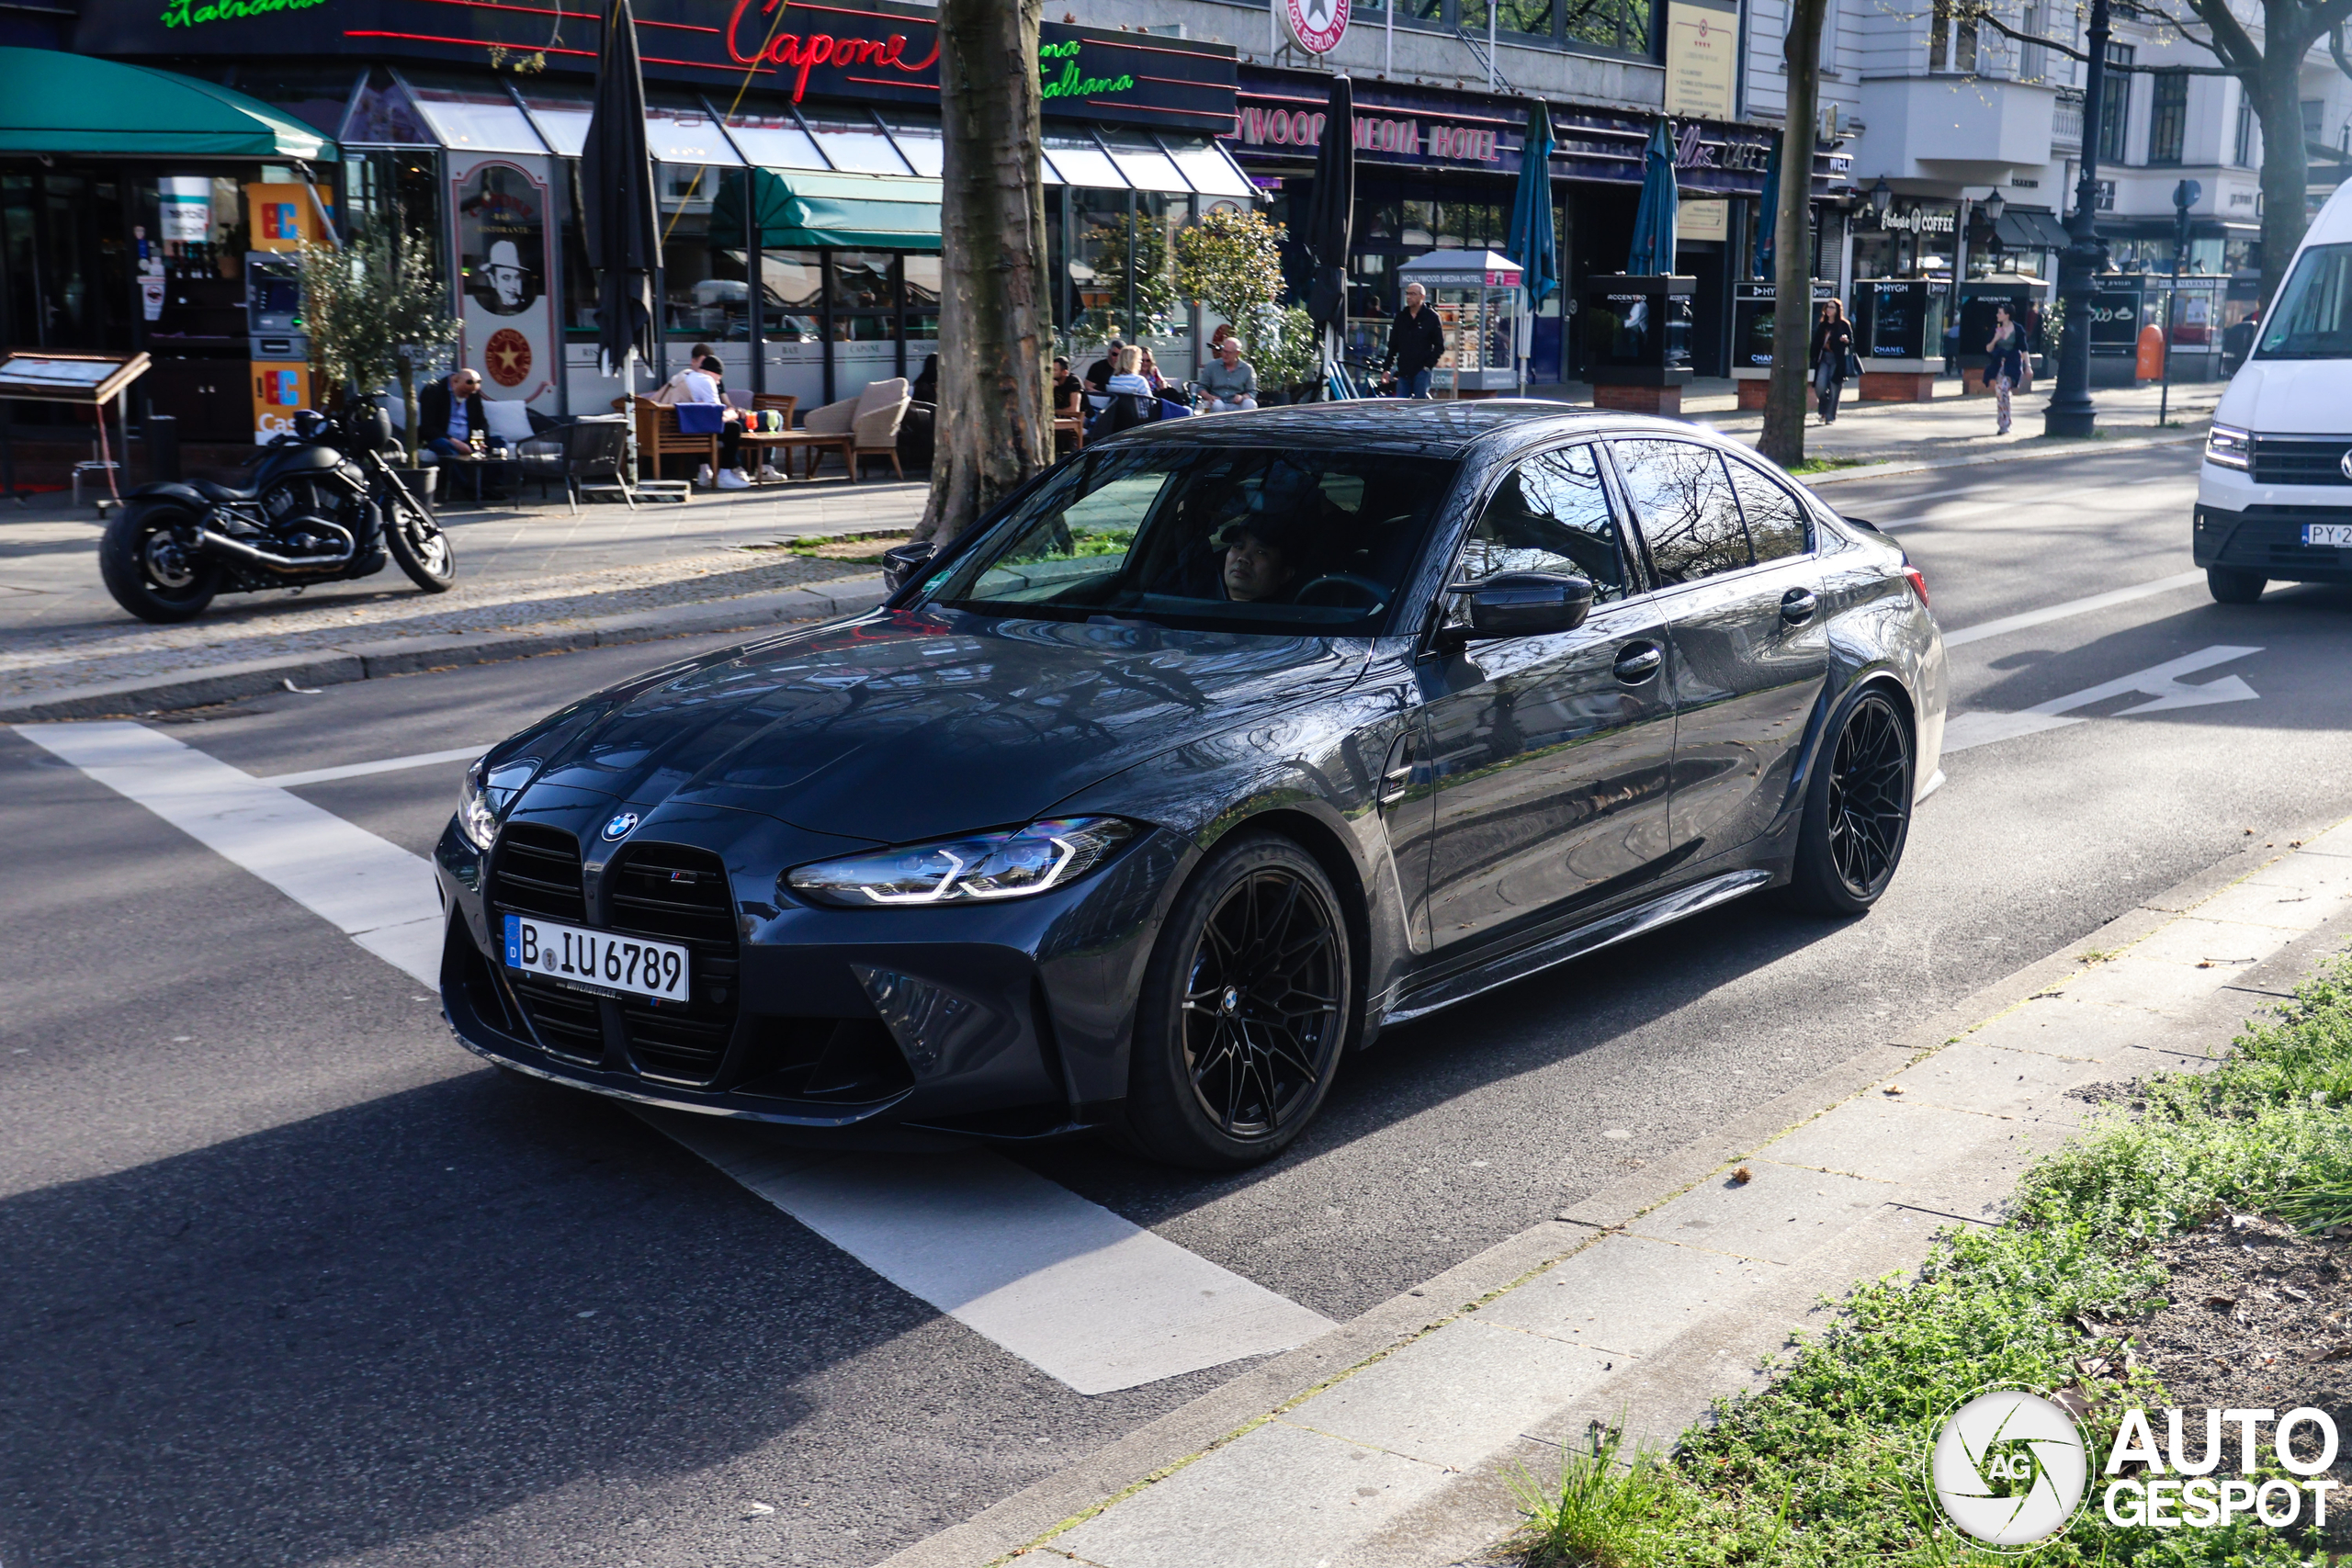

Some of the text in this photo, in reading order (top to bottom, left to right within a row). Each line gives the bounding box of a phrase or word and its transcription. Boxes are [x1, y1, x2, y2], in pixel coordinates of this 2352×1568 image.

[1301, 27, 1336, 51] BERLIN
[727, 0, 939, 105] Capone
[1351, 116, 1420, 155] MEDIA
[1436, 124, 1501, 163] HOTEL
[1921, 214, 1954, 232] COFFEE
[1402, 275, 1441, 283] HOLLYWOOD
[1441, 275, 1461, 283] MEDIA
[1462, 275, 1482, 283] HOTEL
[1883, 284, 1908, 292] HYGH
[1763, 287, 1776, 296] HY
[1751, 354, 1773, 362] CHAN
[1873, 345, 1905, 354] CHANEL
[258, 412, 296, 433] Cas
[2312, 525, 2335, 543] PY
[509, 945, 517, 959] D
[521, 923, 539, 965] B
[604, 940, 682, 992] 6789
